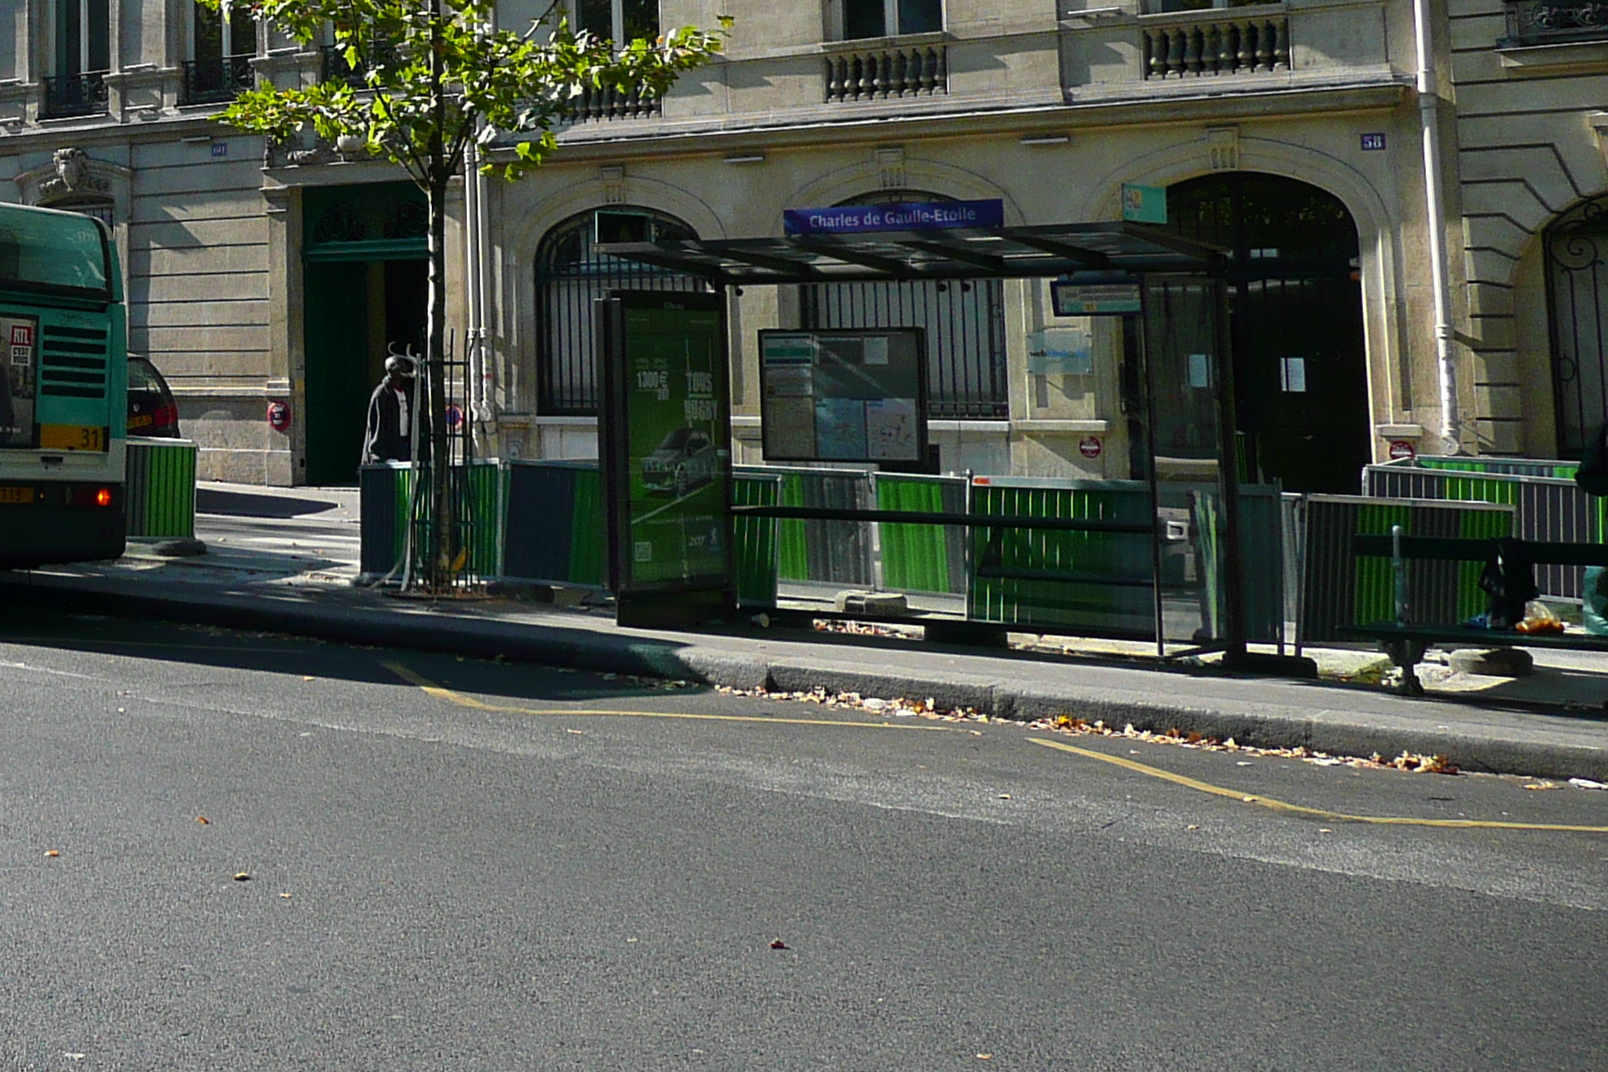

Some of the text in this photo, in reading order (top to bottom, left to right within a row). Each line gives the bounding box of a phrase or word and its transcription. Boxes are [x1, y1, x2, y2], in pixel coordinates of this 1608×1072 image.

[1363, 135, 1382, 149] 58
[809, 207, 976, 228] Charles de Gaulle-Etoile
[13, 327, 29, 344] RTL
[80, 428, 98, 448] 31
